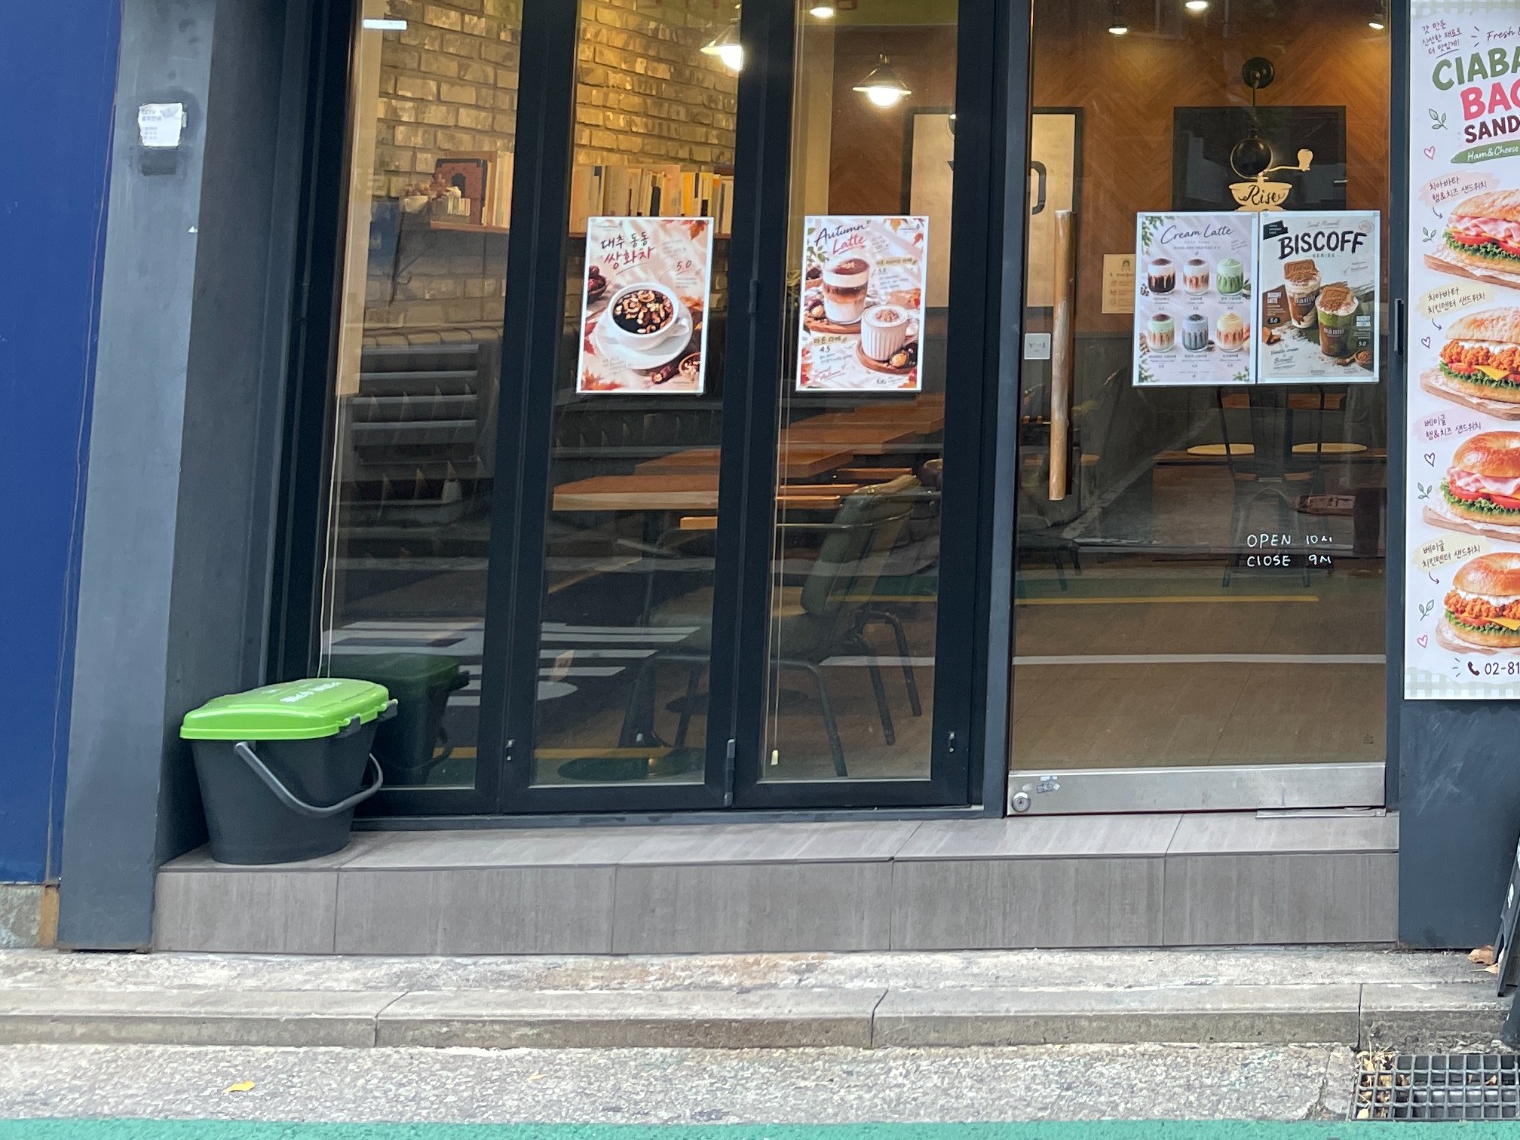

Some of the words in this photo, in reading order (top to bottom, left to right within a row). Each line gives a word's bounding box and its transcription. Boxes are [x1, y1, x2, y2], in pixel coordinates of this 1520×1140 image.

[1487, 26, 1515, 42] Fresh
[1430, 176, 1460, 190] 치아바타
[1240, 184, 1285, 206] Rise
[601, 234, 625, 250] 대추
[814, 224, 866, 246] Autumn
[1160, 224, 1201, 245] Cream
[1203, 224, 1235, 238] Latte
[832, 234, 867, 254] Latte
[1278, 230, 1368, 260] BISCOFF
[604, 247, 655, 270] 쌍화차
[676, 260, 692, 271] 5.0
[1424, 414, 1446, 427] 베이글
[1246, 533, 1292, 548] OPEN
